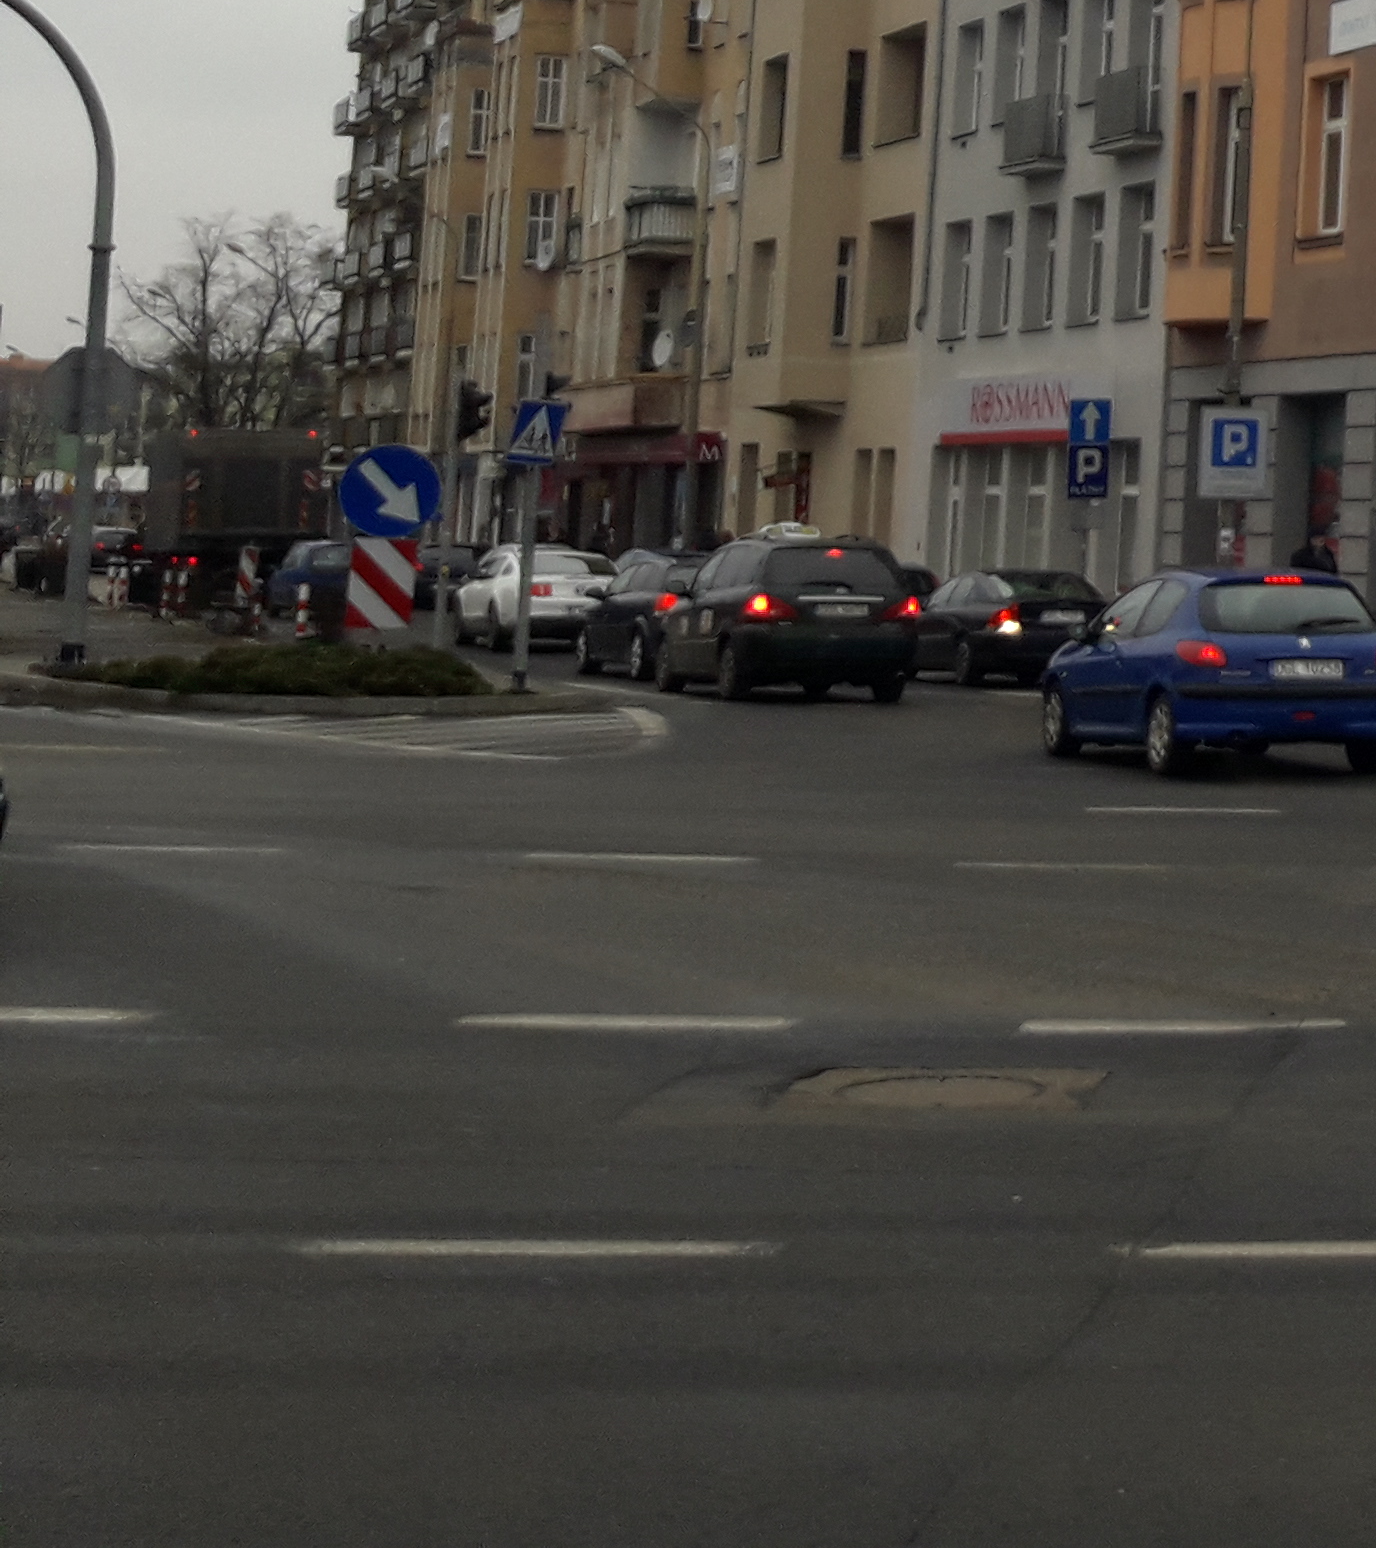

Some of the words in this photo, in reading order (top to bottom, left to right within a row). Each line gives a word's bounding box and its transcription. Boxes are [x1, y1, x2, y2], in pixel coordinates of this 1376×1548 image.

[970, 380, 1070, 424] ROSSMANN
[1221, 423, 1250, 463] P
[1076, 447, 1103, 484] P
